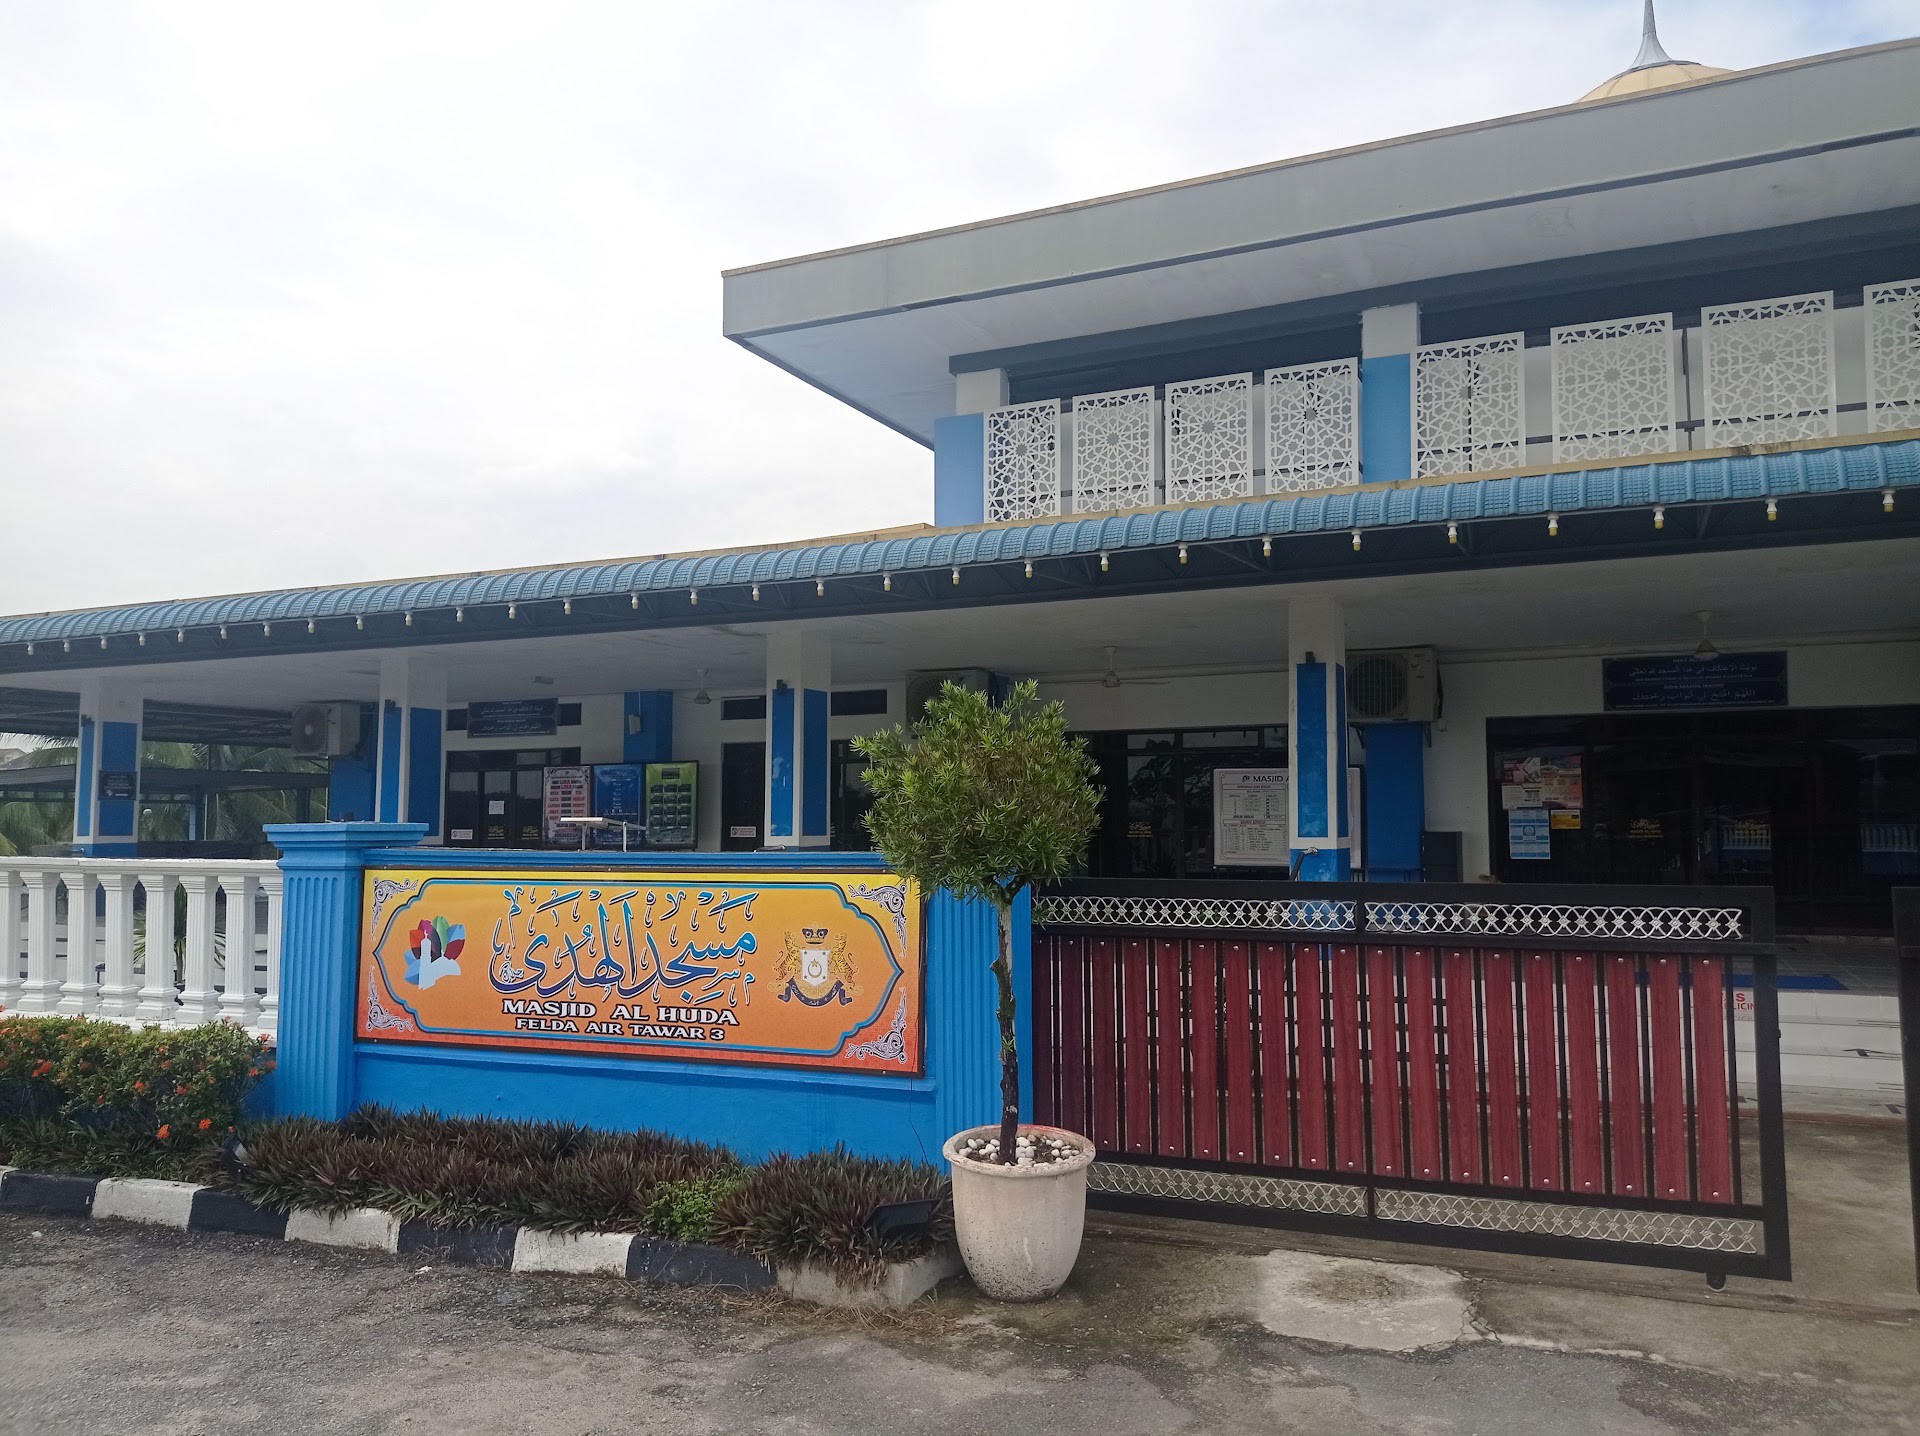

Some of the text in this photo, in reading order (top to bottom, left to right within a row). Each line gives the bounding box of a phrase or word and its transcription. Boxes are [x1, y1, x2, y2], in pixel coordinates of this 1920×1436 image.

[1253, 775, 1284, 783] MASJID
[502, 999, 739, 1026] MASJID AL HUDA
[516, 1018, 725, 1040] FELDA AIR TAWAR 3
